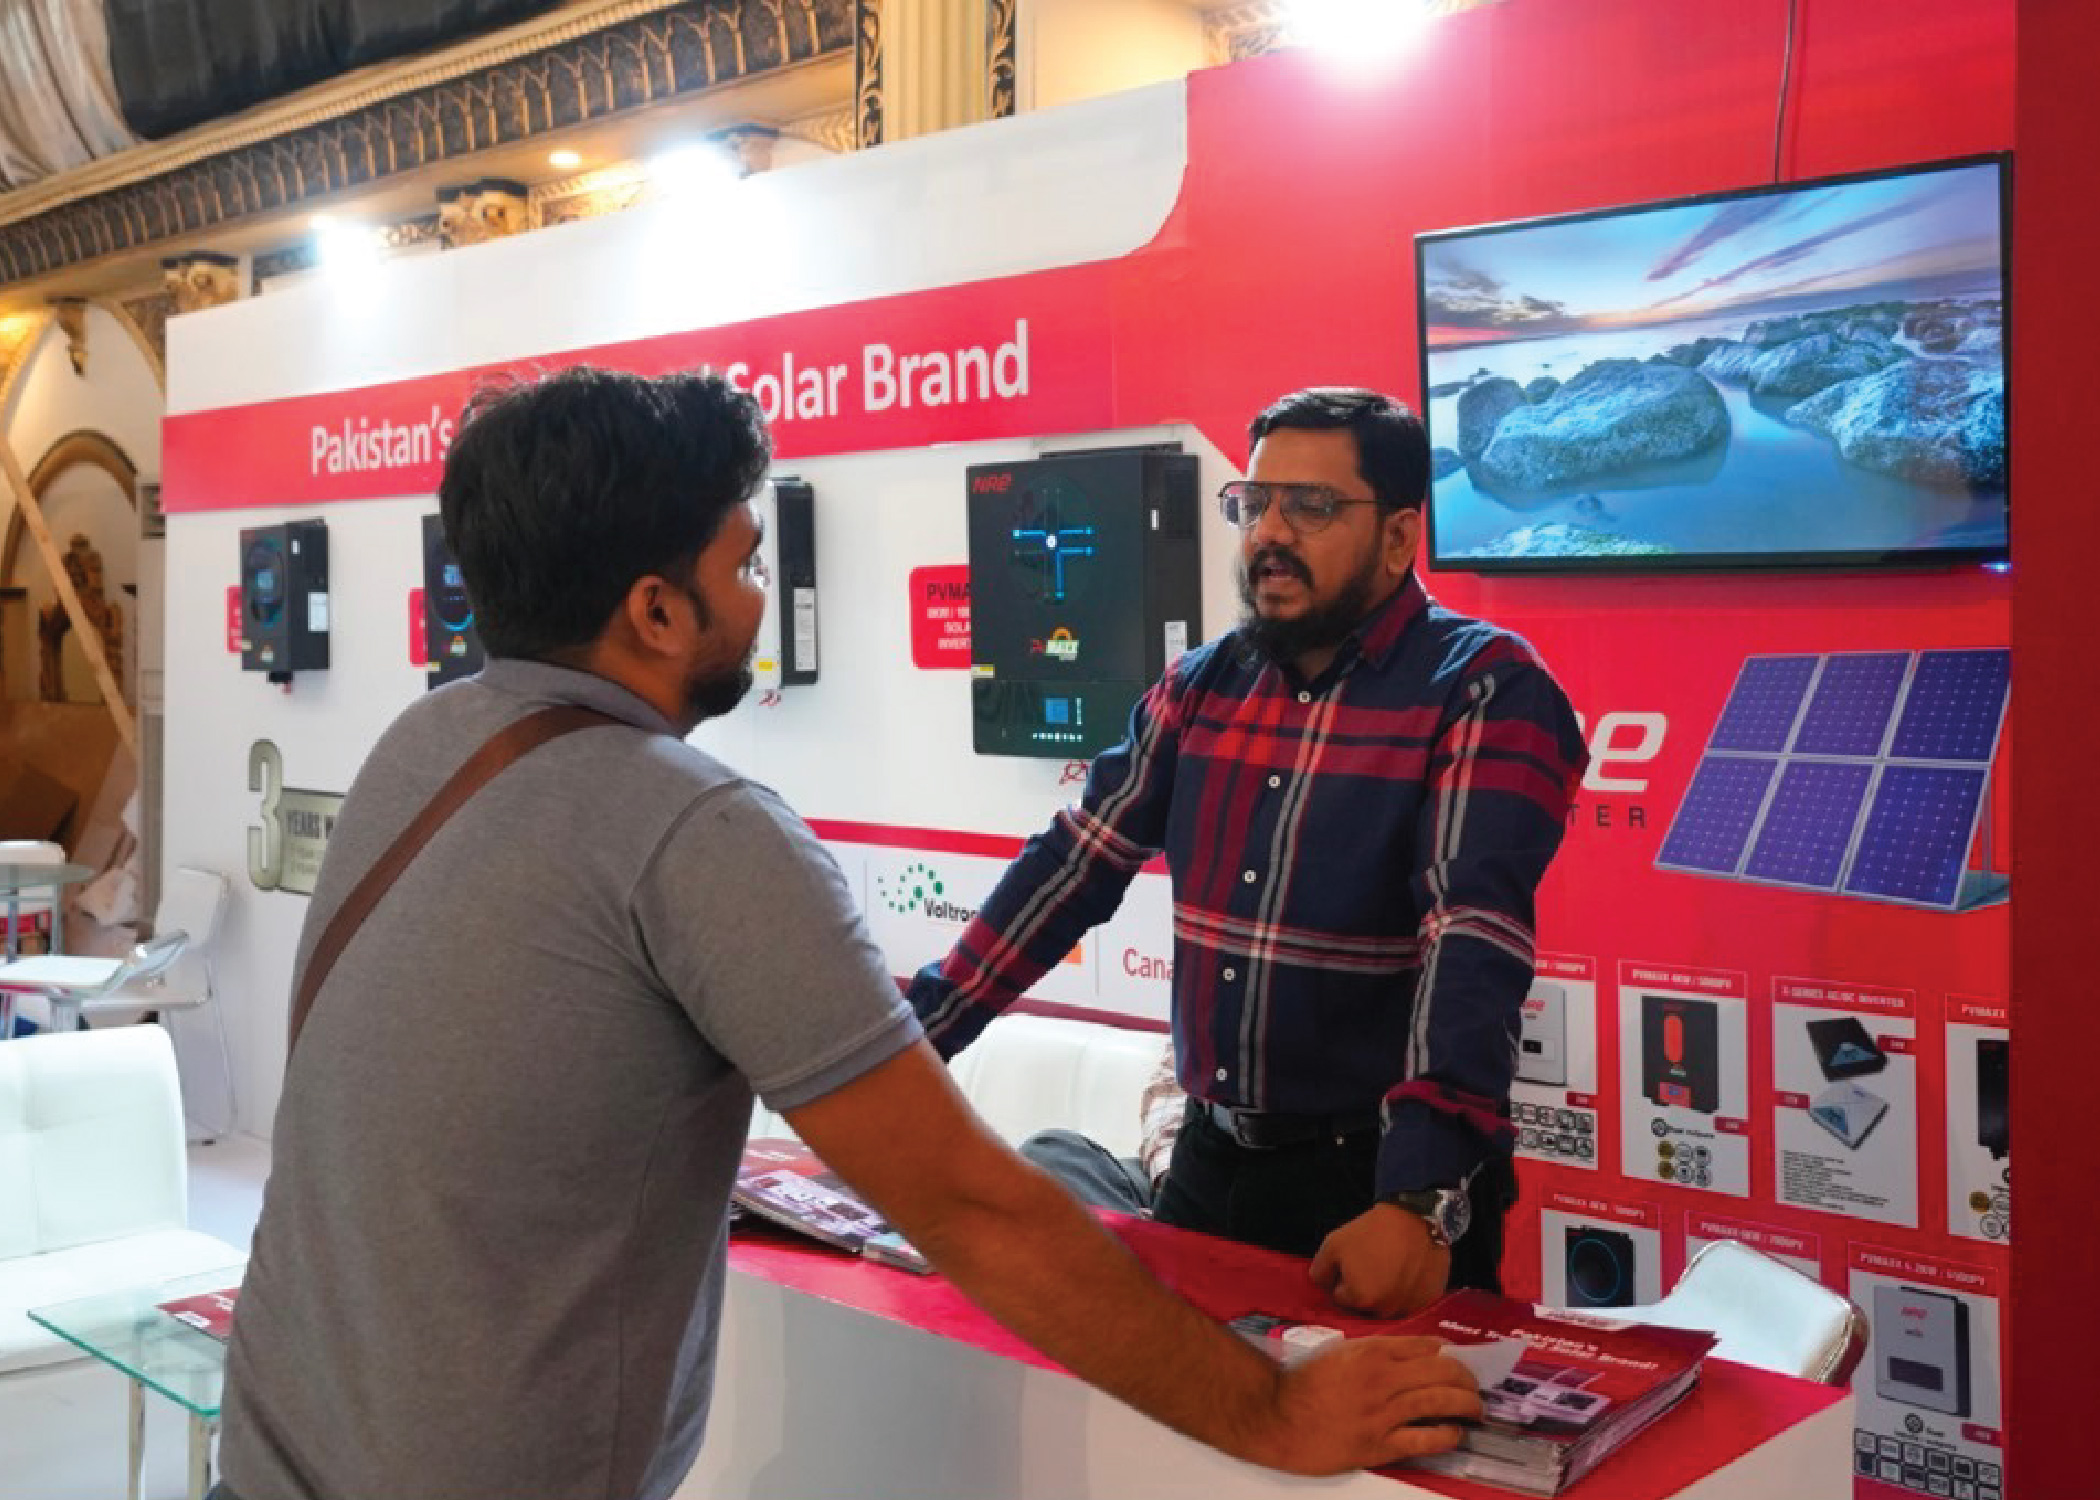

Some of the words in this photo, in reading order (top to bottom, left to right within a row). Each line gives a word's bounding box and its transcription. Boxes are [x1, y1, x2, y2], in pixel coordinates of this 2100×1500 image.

[310, 403, 454, 477] Pakistan's
[862, 318, 1030, 412] Brand
[248, 738, 283, 891] 3
